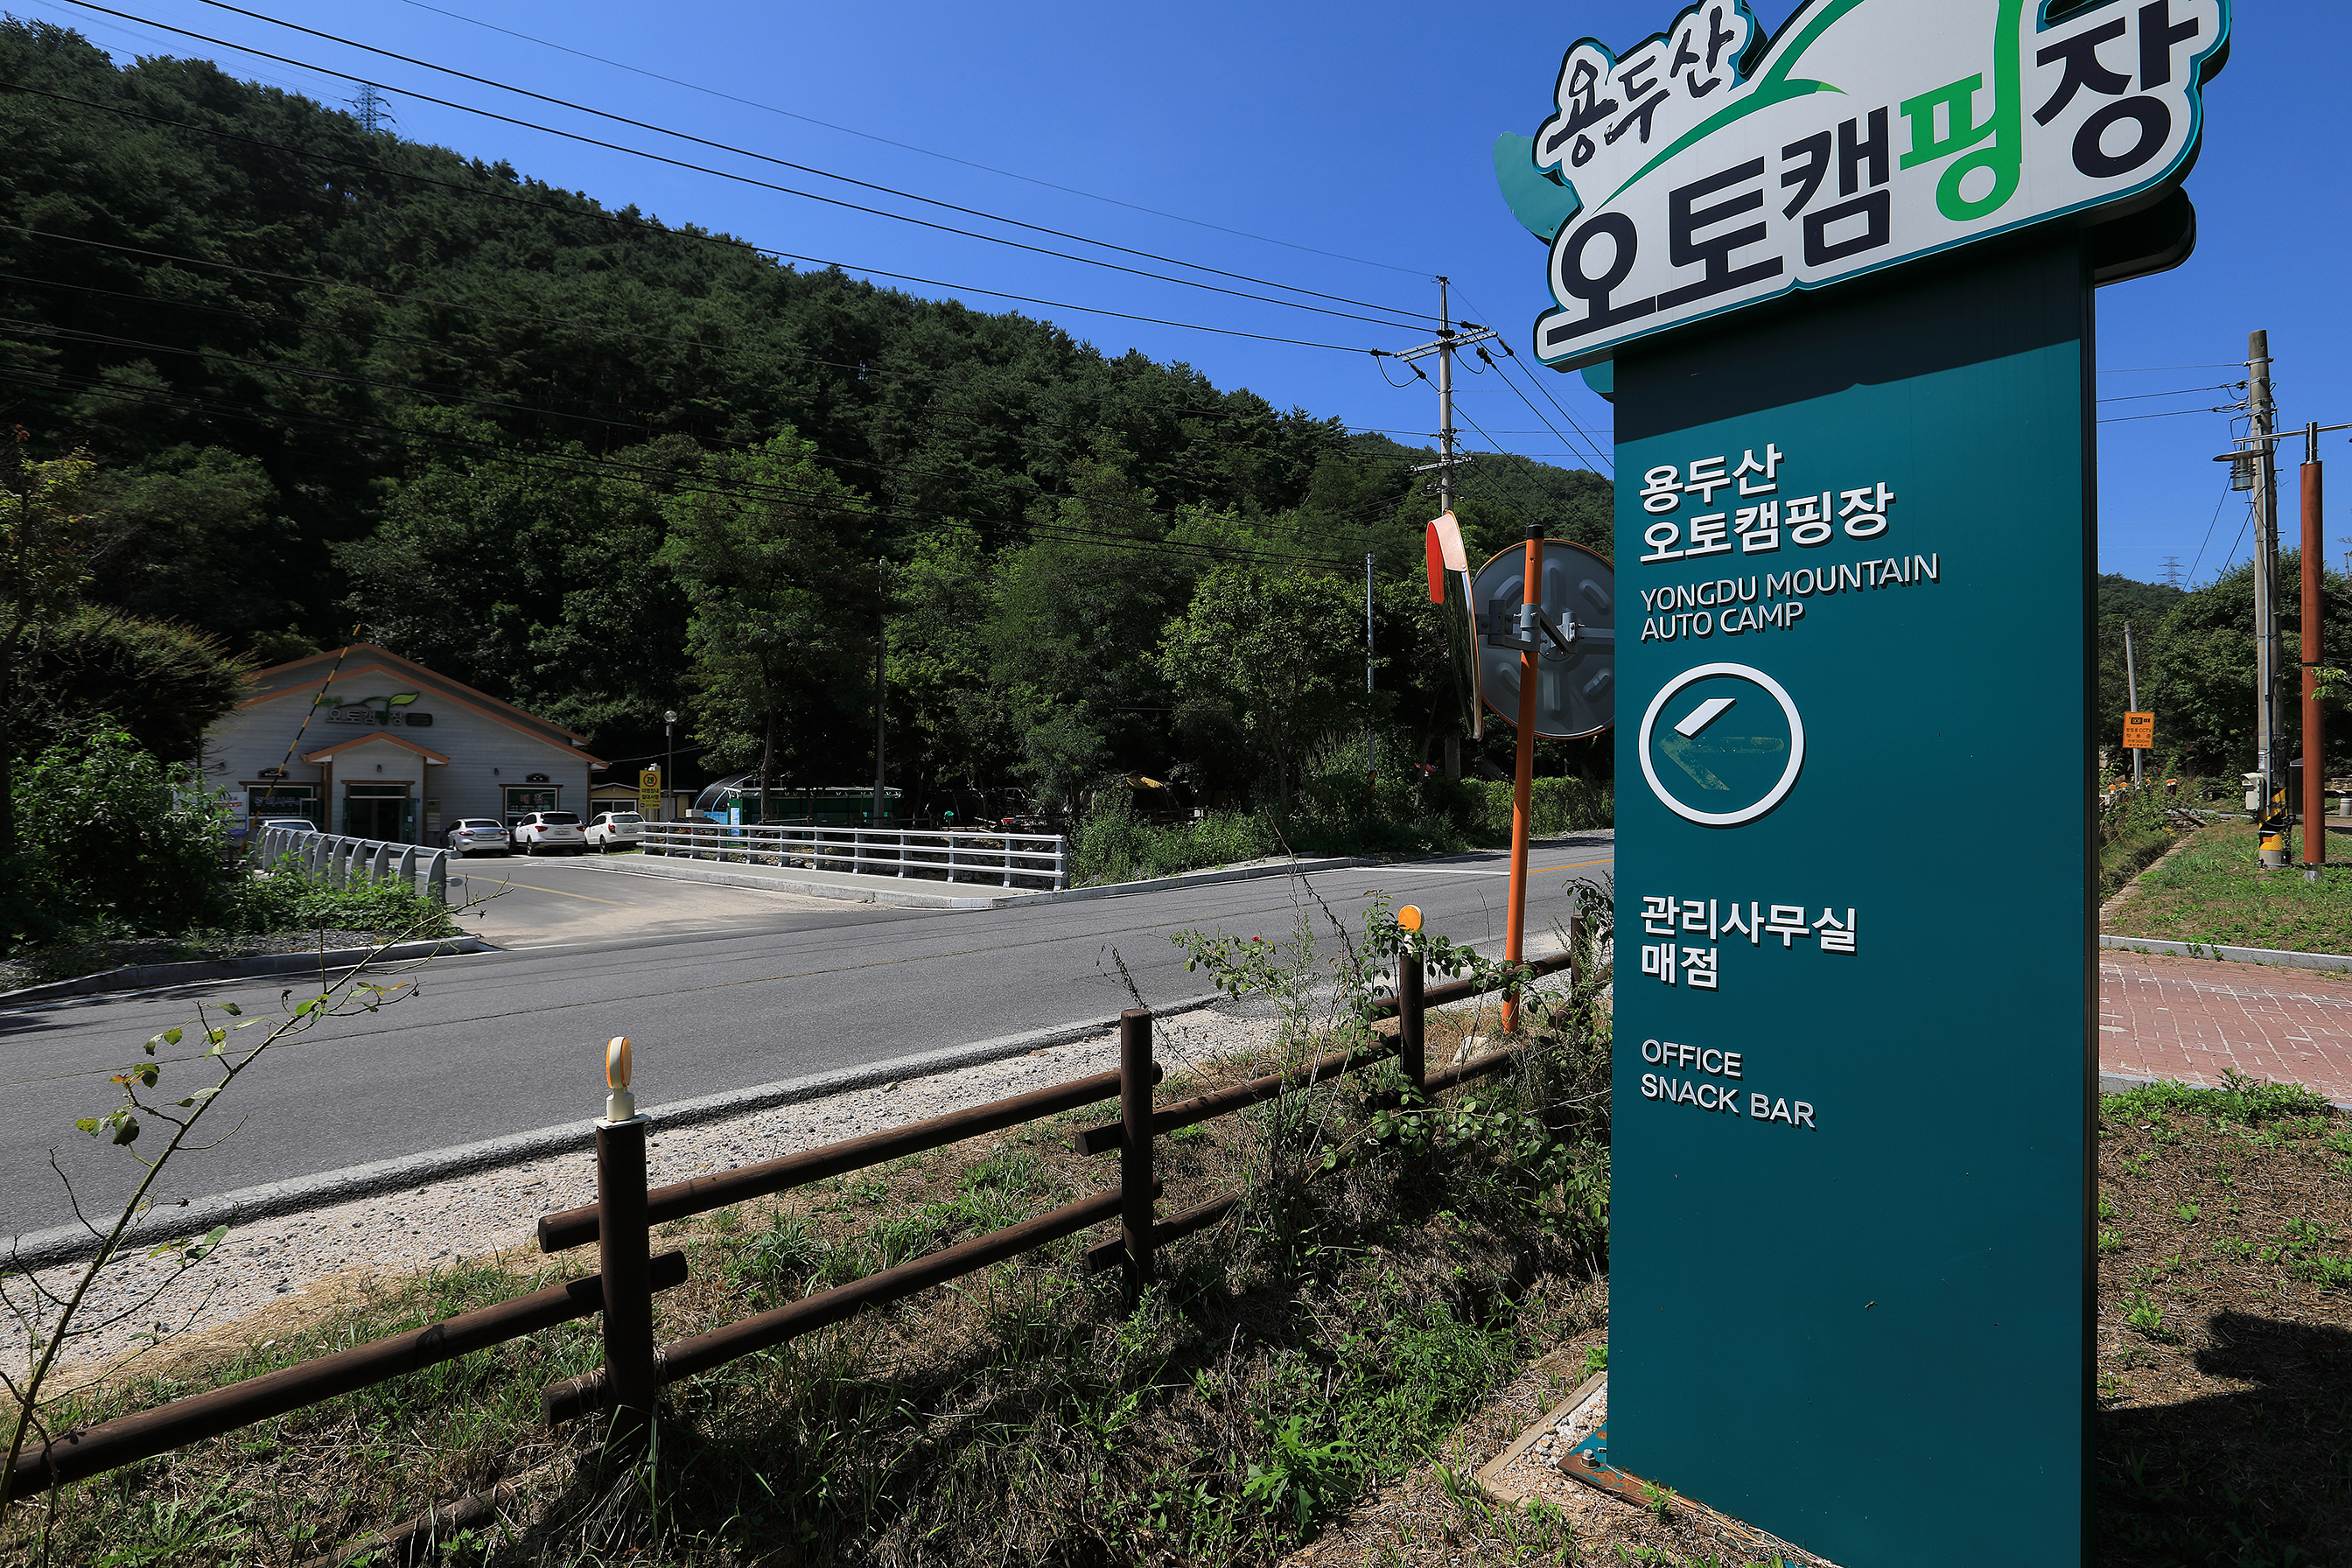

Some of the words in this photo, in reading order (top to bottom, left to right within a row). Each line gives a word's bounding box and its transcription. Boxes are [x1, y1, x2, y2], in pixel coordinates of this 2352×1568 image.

[1546, 5, 1735, 167] 용두산
[1546, 0, 2200, 346] 오토캠핑장
[1640, 443, 1782, 513] 용두산
[1640, 482, 1894, 563] 오토캠핑장
[1641, 575, 1757, 612] YONGDU
[1766, 553, 1938, 598] MOUNTAIN
[1641, 612, 1712, 640] AUTO
[1720, 602, 1803, 632] CAMP
[1641, 895, 1856, 952] 관리사무실
[1642, 943, 1718, 989] 매점
[1642, 1039, 1742, 1077] OFFICE
[1641, 1074, 1740, 1113] SNACK
[1751, 1093, 1816, 1129] BAR
